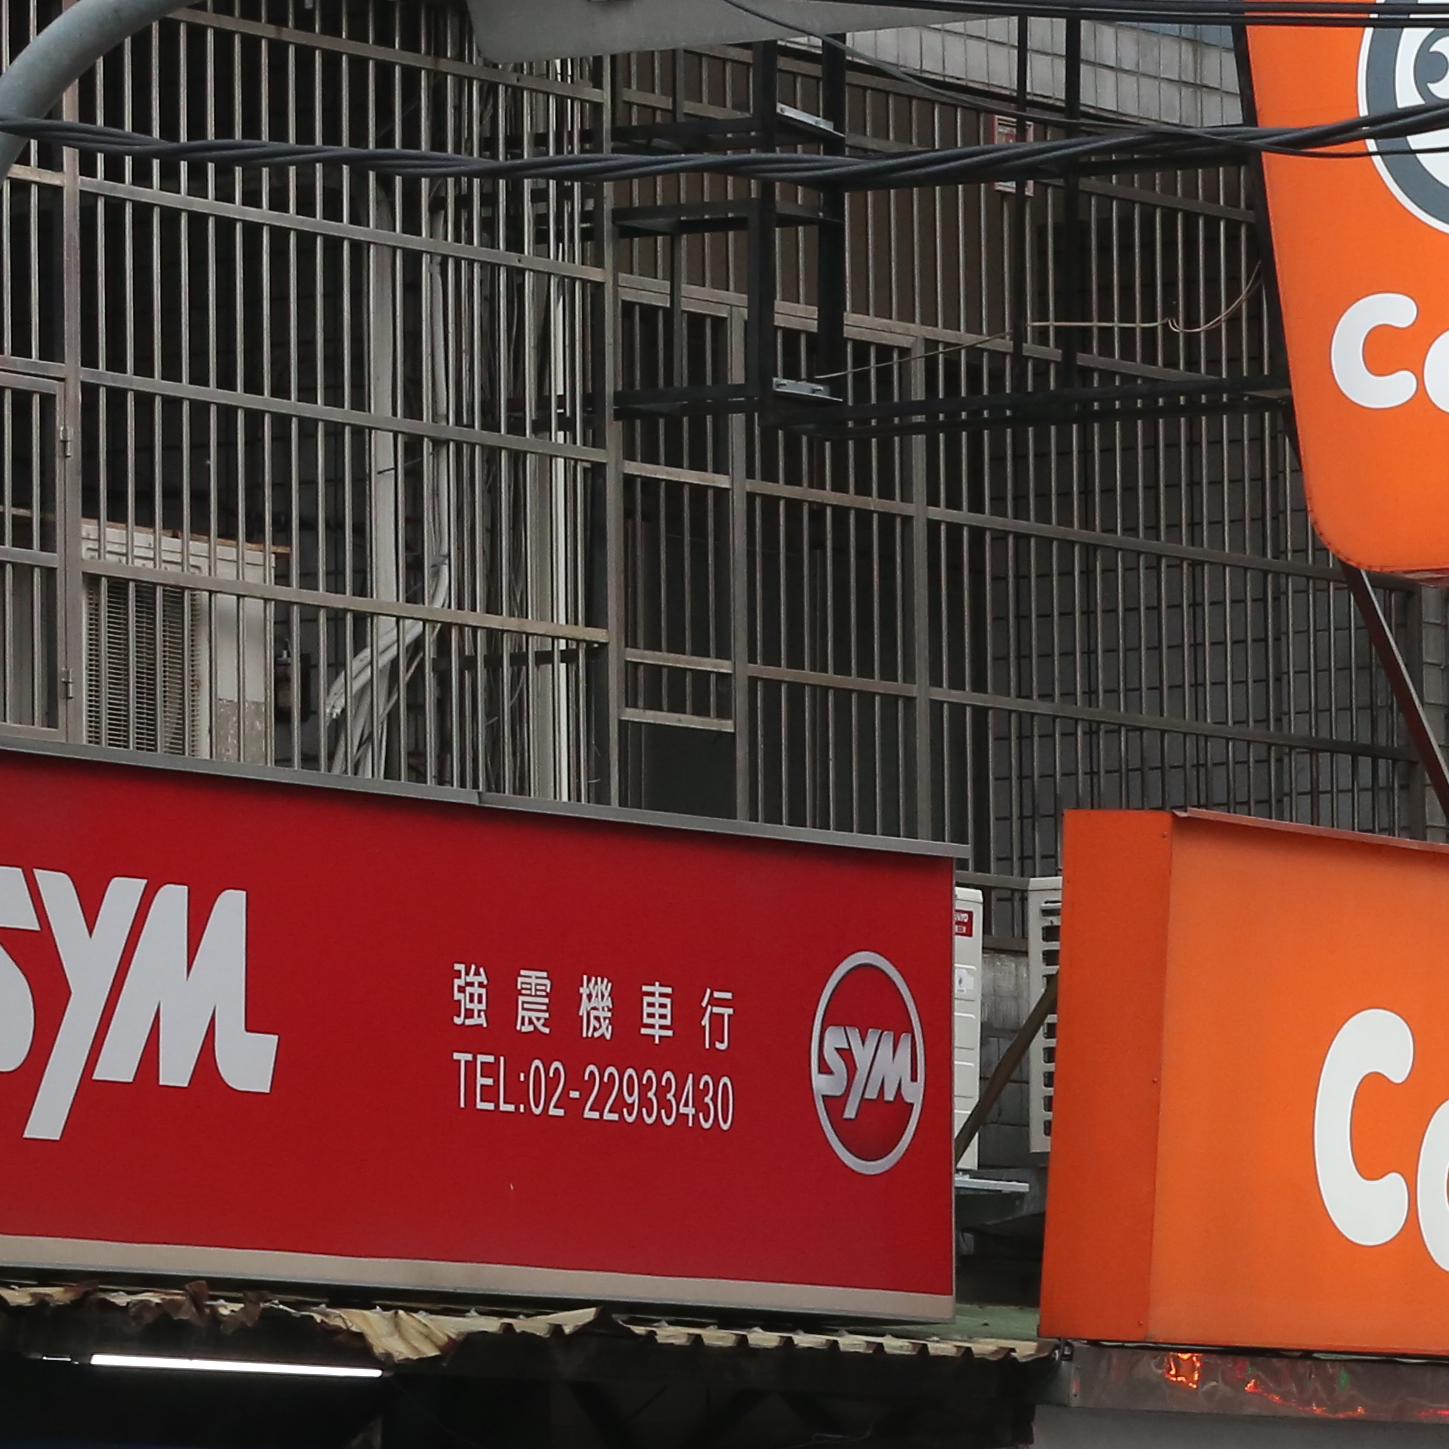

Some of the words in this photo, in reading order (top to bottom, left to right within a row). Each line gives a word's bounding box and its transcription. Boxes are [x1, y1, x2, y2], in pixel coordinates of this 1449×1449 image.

[453, 963, 736, 1052] 強震機車行
[453, 1050, 737, 1132] TEL:02-22933430
[814, 1023, 921, 1121] SYM
